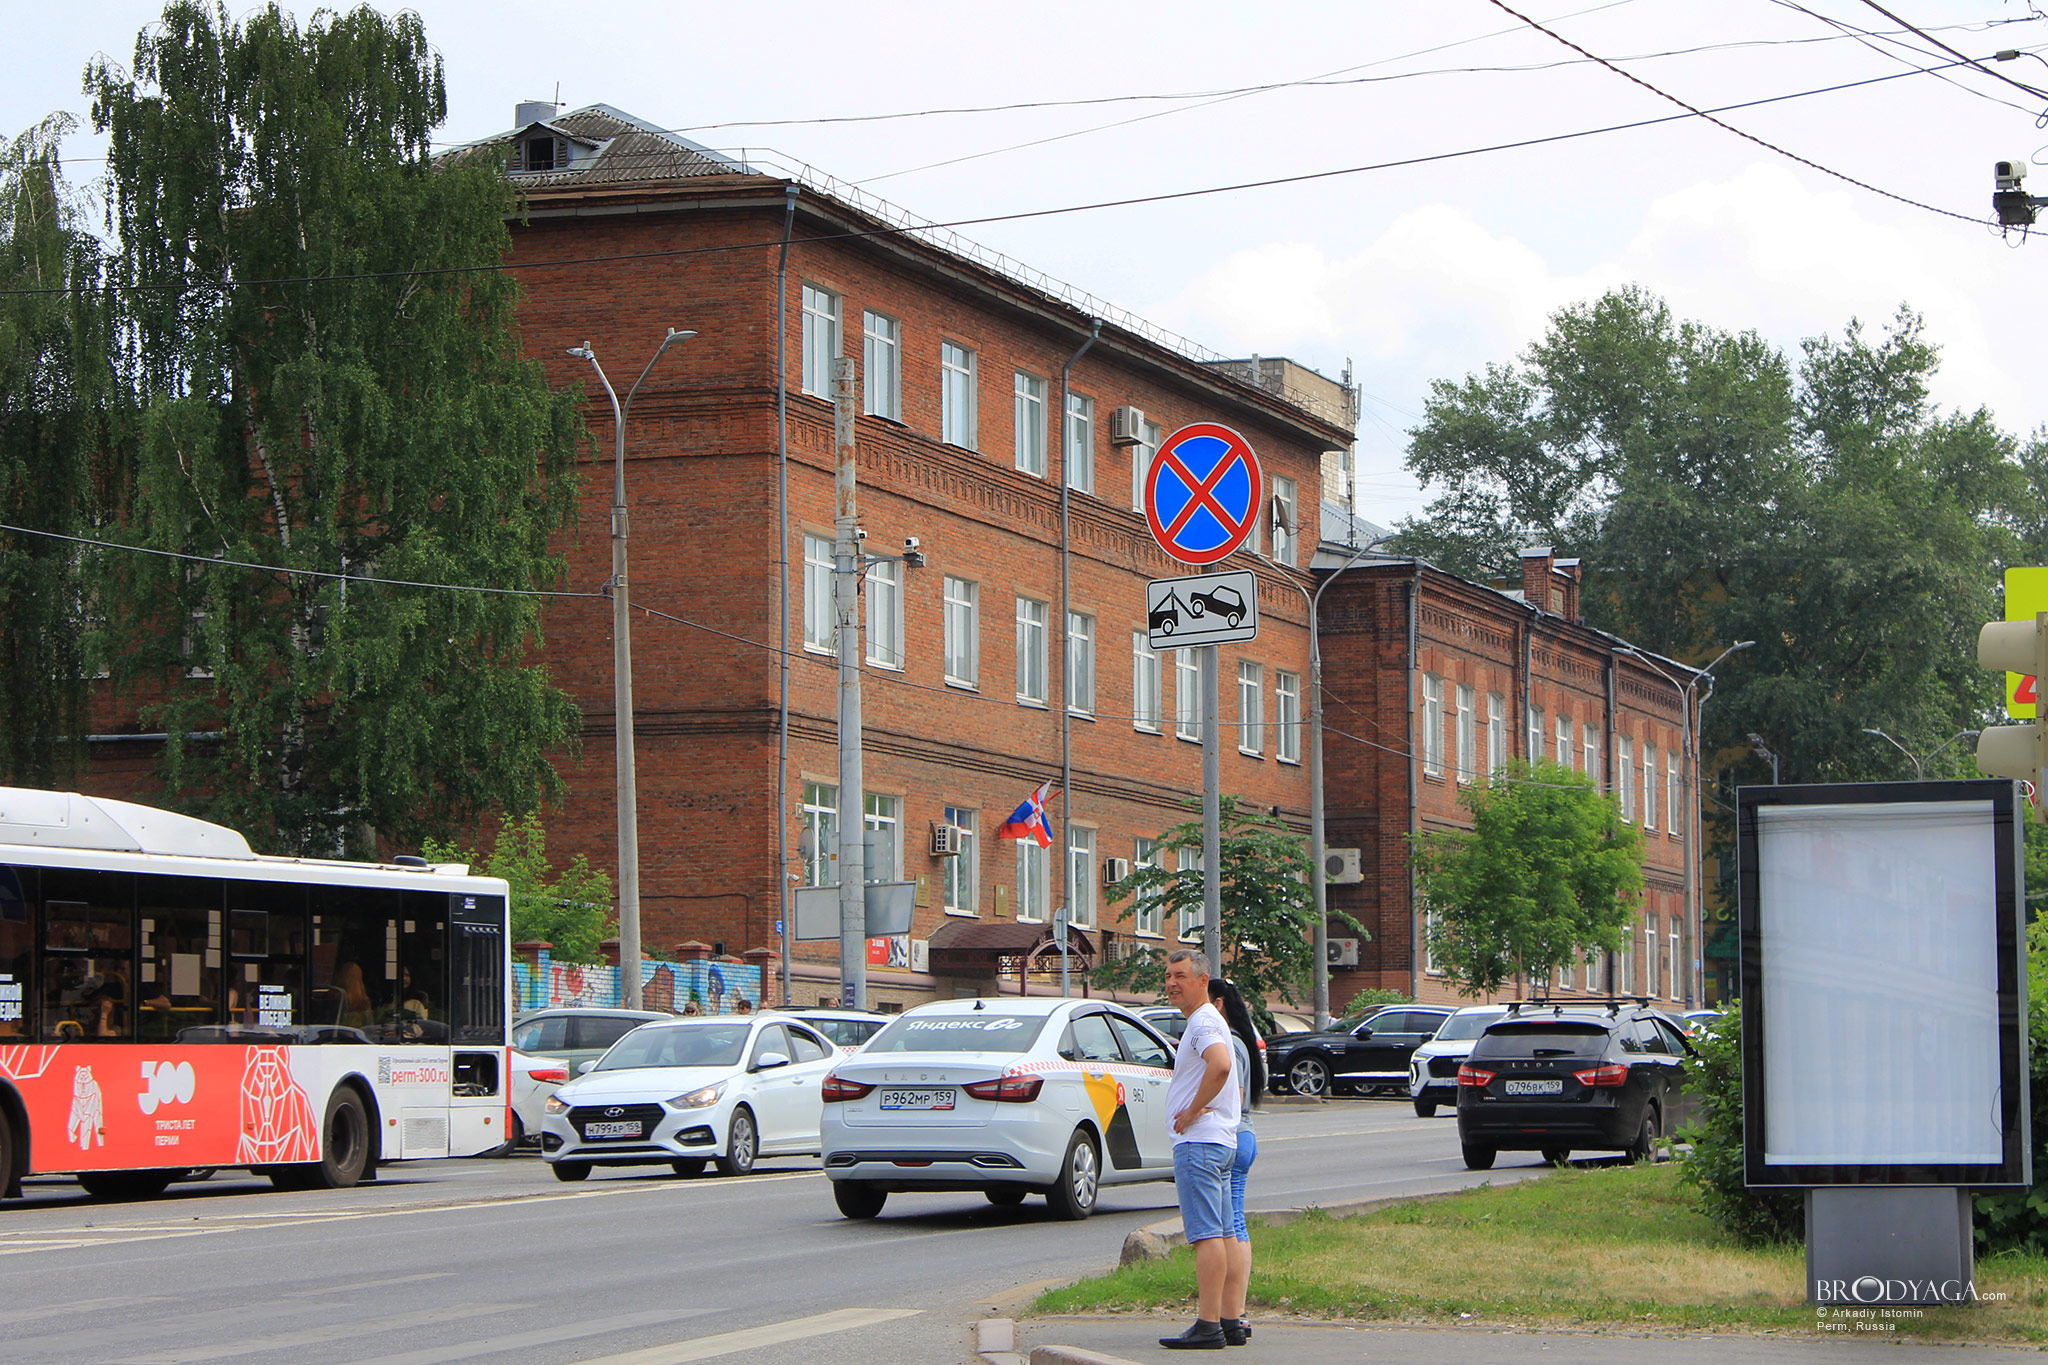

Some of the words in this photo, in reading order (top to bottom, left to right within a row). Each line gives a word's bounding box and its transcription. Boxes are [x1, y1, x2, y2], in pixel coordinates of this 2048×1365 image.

[906, 1020, 985, 1031] Яндекс
[391, 1067, 448, 1087] perm-300.ru
[884, 1073, 947, 1081] LADA
[138, 1060, 196, 1115] 300
[933, 1091, 952, 1102] 159
[155, 1135, 180, 1146] ПЕРМИ
